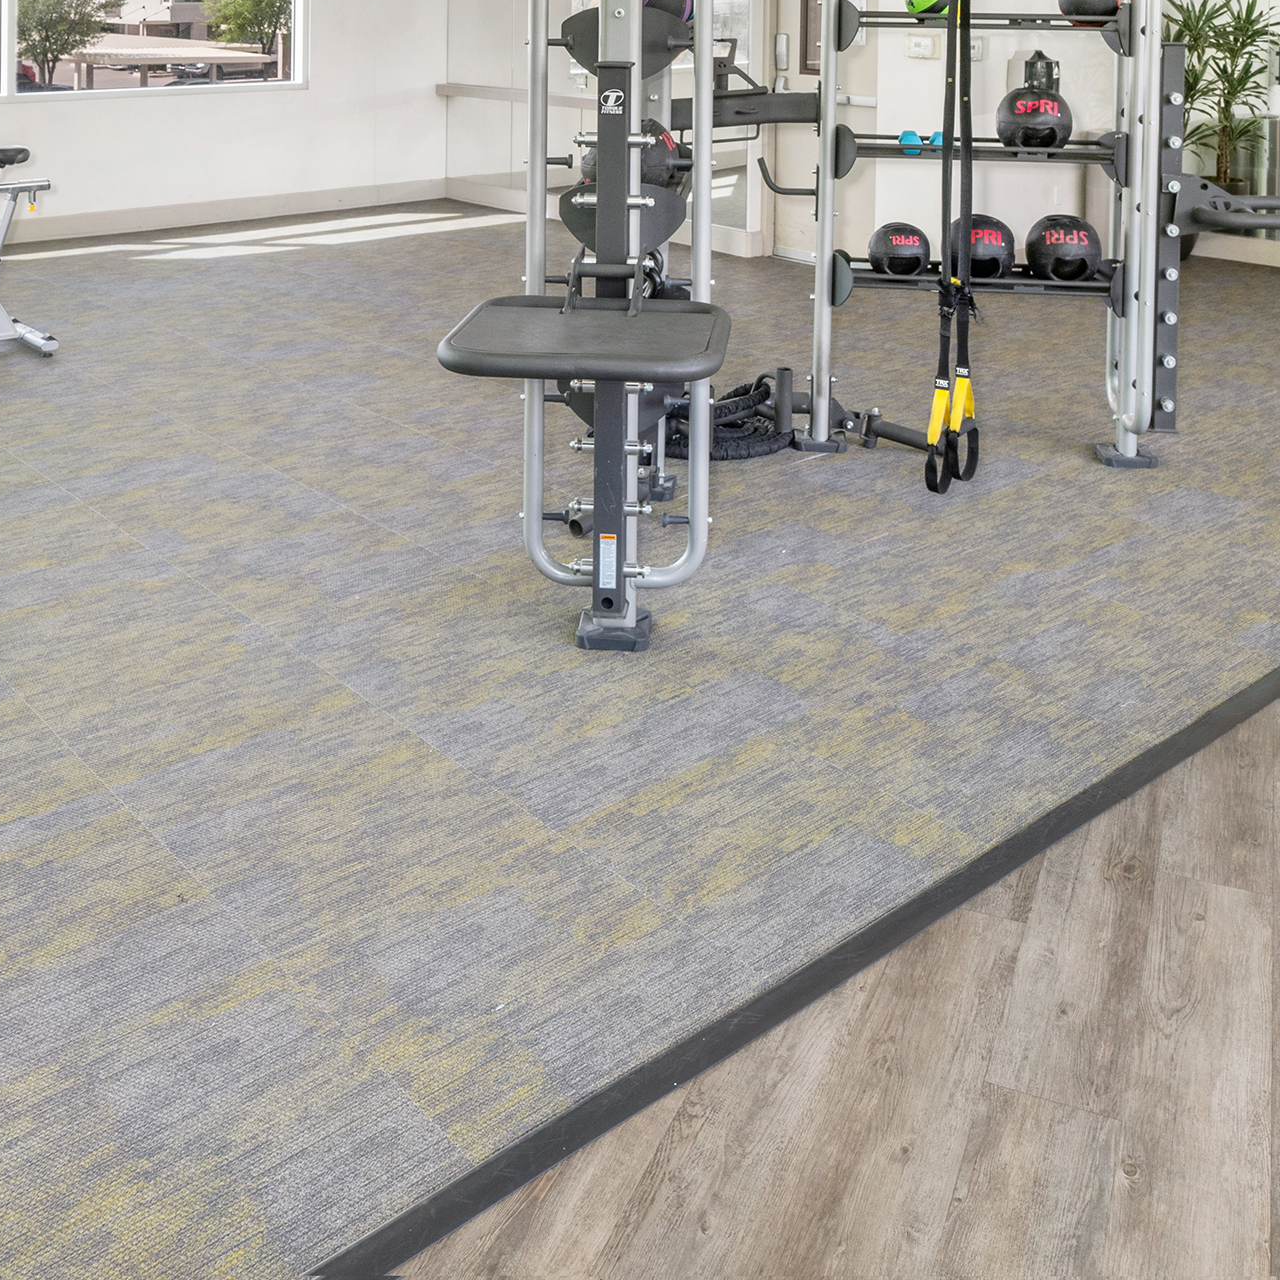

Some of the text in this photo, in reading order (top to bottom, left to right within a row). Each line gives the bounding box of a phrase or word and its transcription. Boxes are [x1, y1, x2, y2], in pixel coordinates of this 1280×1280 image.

[1015, 99, 1058, 116] SPRI
[892, 235, 920, 246] SPRI
[971, 229, 1002, 246] PRI
[1045, 229, 1089, 246] SPRI
